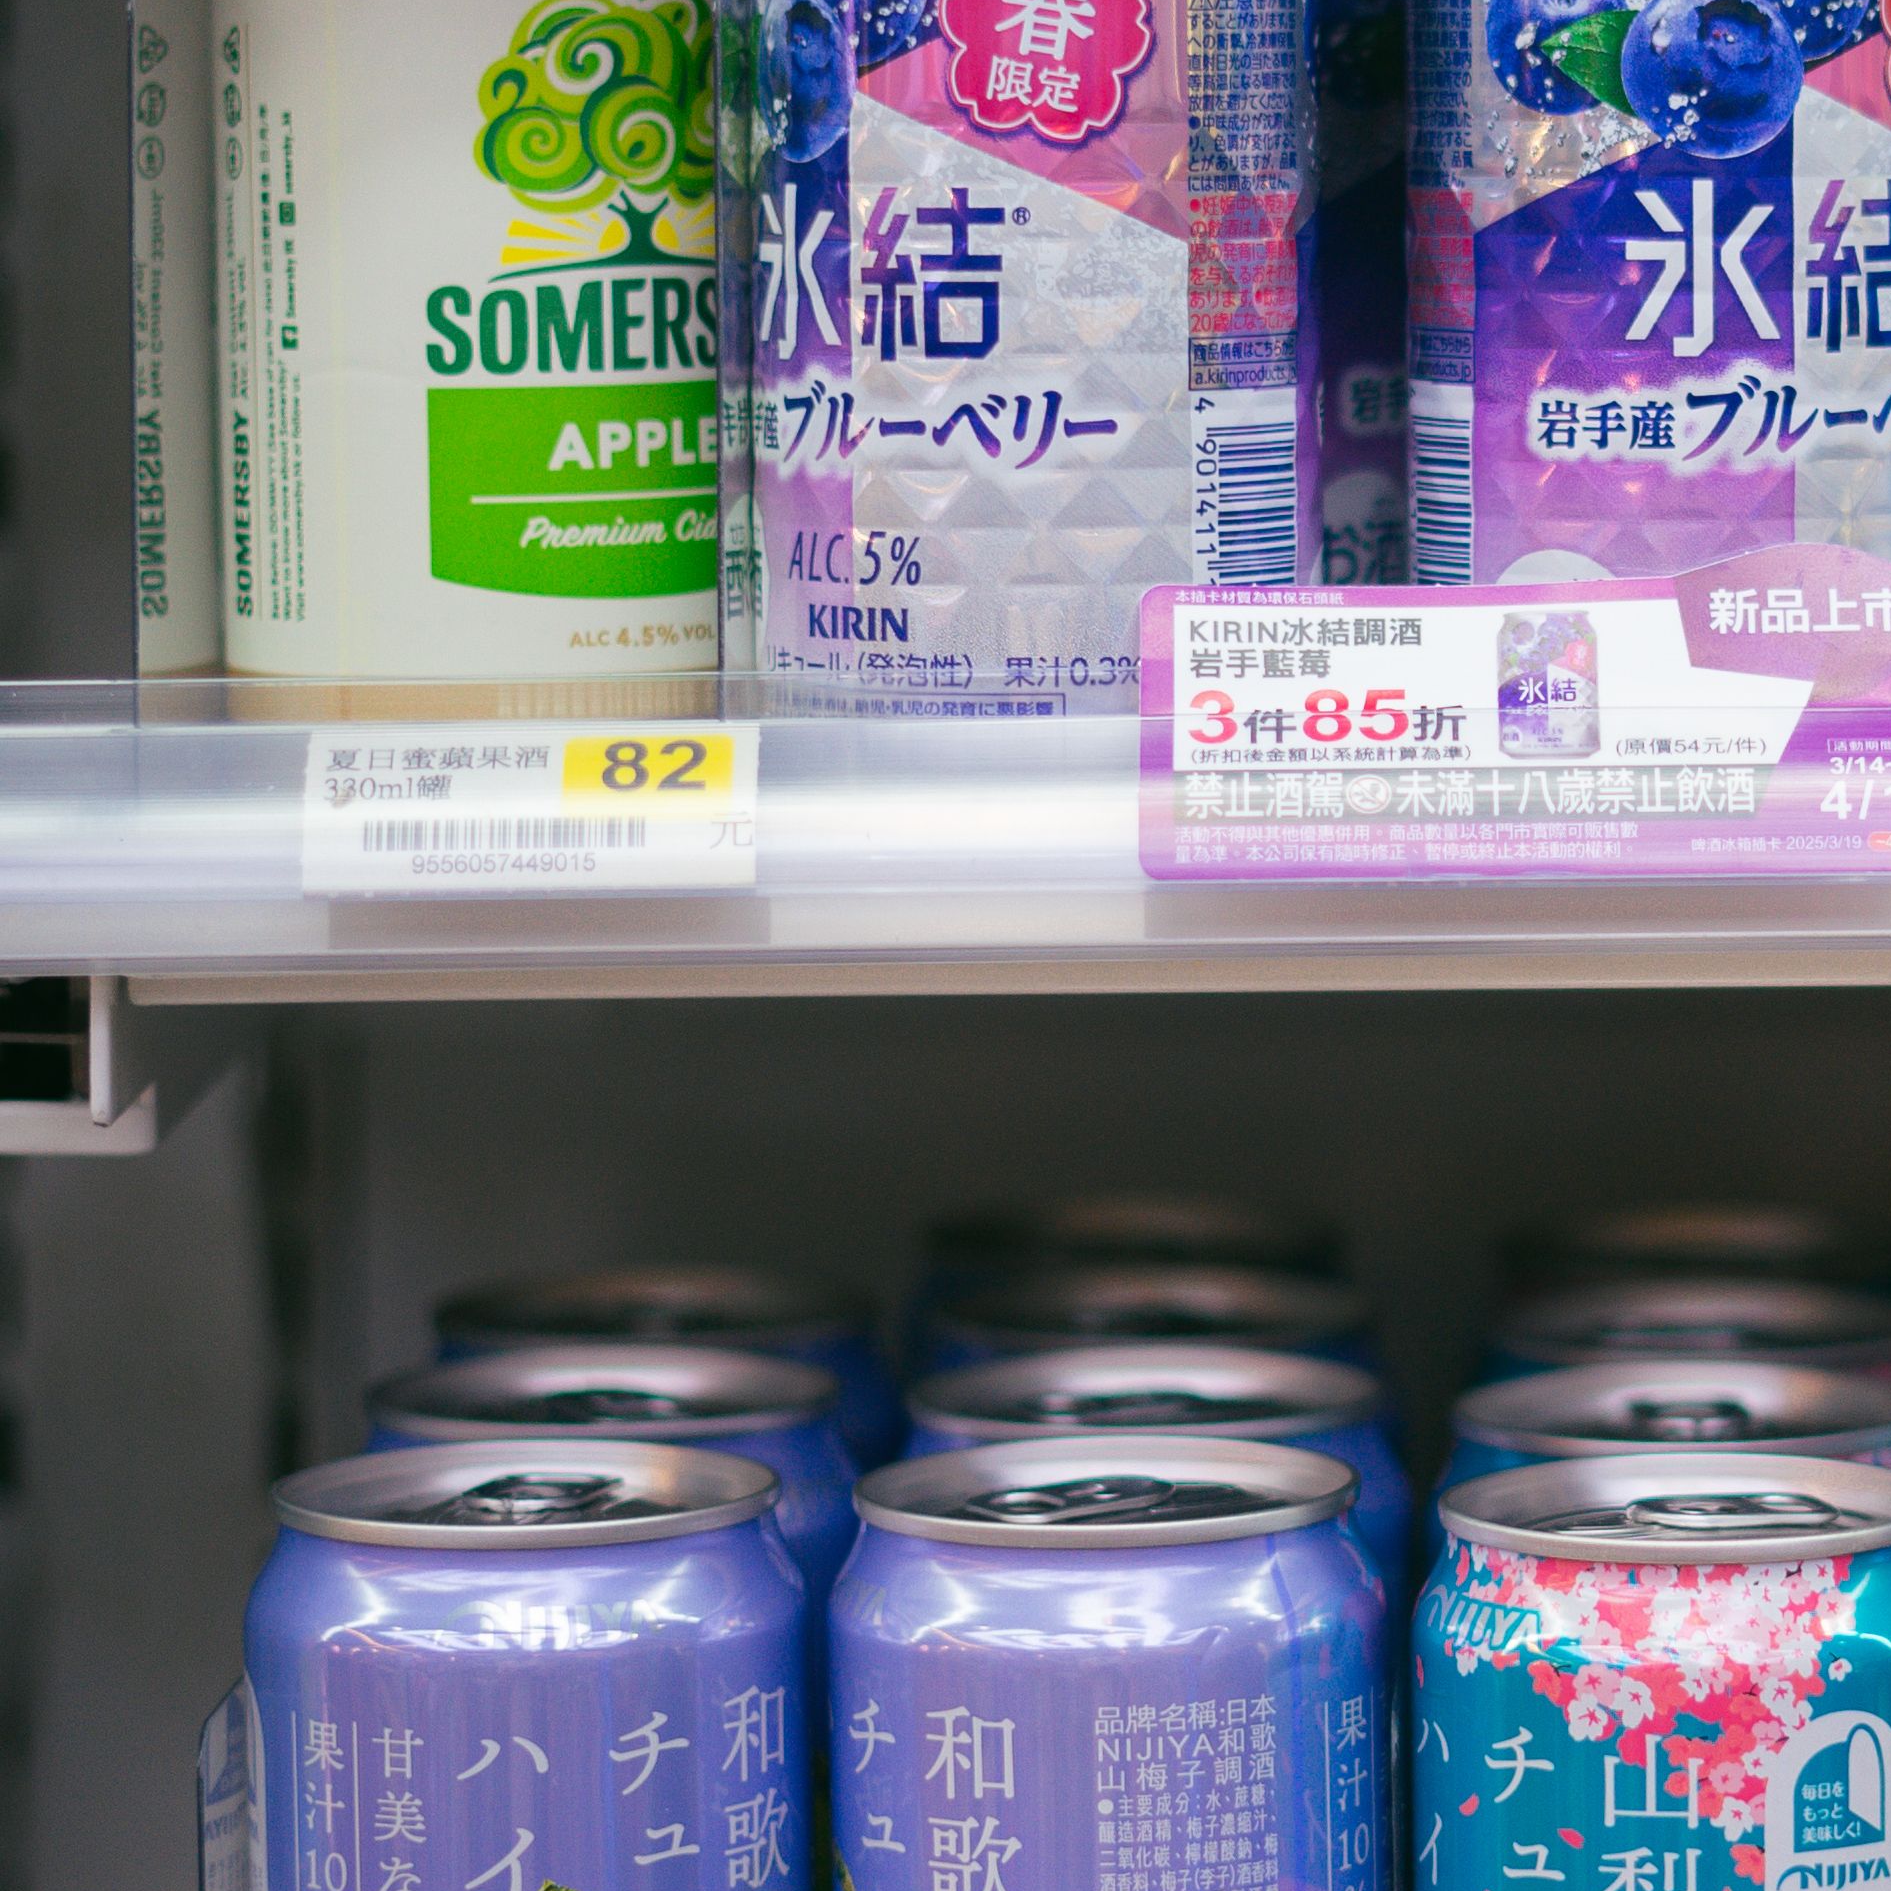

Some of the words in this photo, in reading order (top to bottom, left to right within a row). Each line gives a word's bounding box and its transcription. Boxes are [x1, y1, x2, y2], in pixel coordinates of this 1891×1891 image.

[987, 62, 1082, 117] 限定
[232, 411, 255, 620] SOMERSBY
[520, 511, 668, 551] Premium
[858, 531, 924, 589] 5%
[807, 605, 910, 643] KIRIN
[1189, 616, 1424, 647] KIRIN冰結調酒
[1189, 648, 1332, 680] 岩手藍莓
[1187, 688, 1469, 745] 3件85折
[325, 745, 552, 774] 夏日蜜蘋果酒
[1614, 735, 1768, 757] (原價54元/件)
[601, 739, 709, 795] 82
[1183, 771, 1346, 821] 禁止酒駕
[1397, 766, 1757, 818] 未滿十八歲禁止飲酒
[1785, 833, 1864, 853] 2025/3/19
[411, 852, 597, 875] 9556057449015
[1800, 1780, 1845, 1802] 毎日を
[1801, 1803, 1845, 1824] もっと
[1801, 1820, 1863, 1845] 美味しく!
